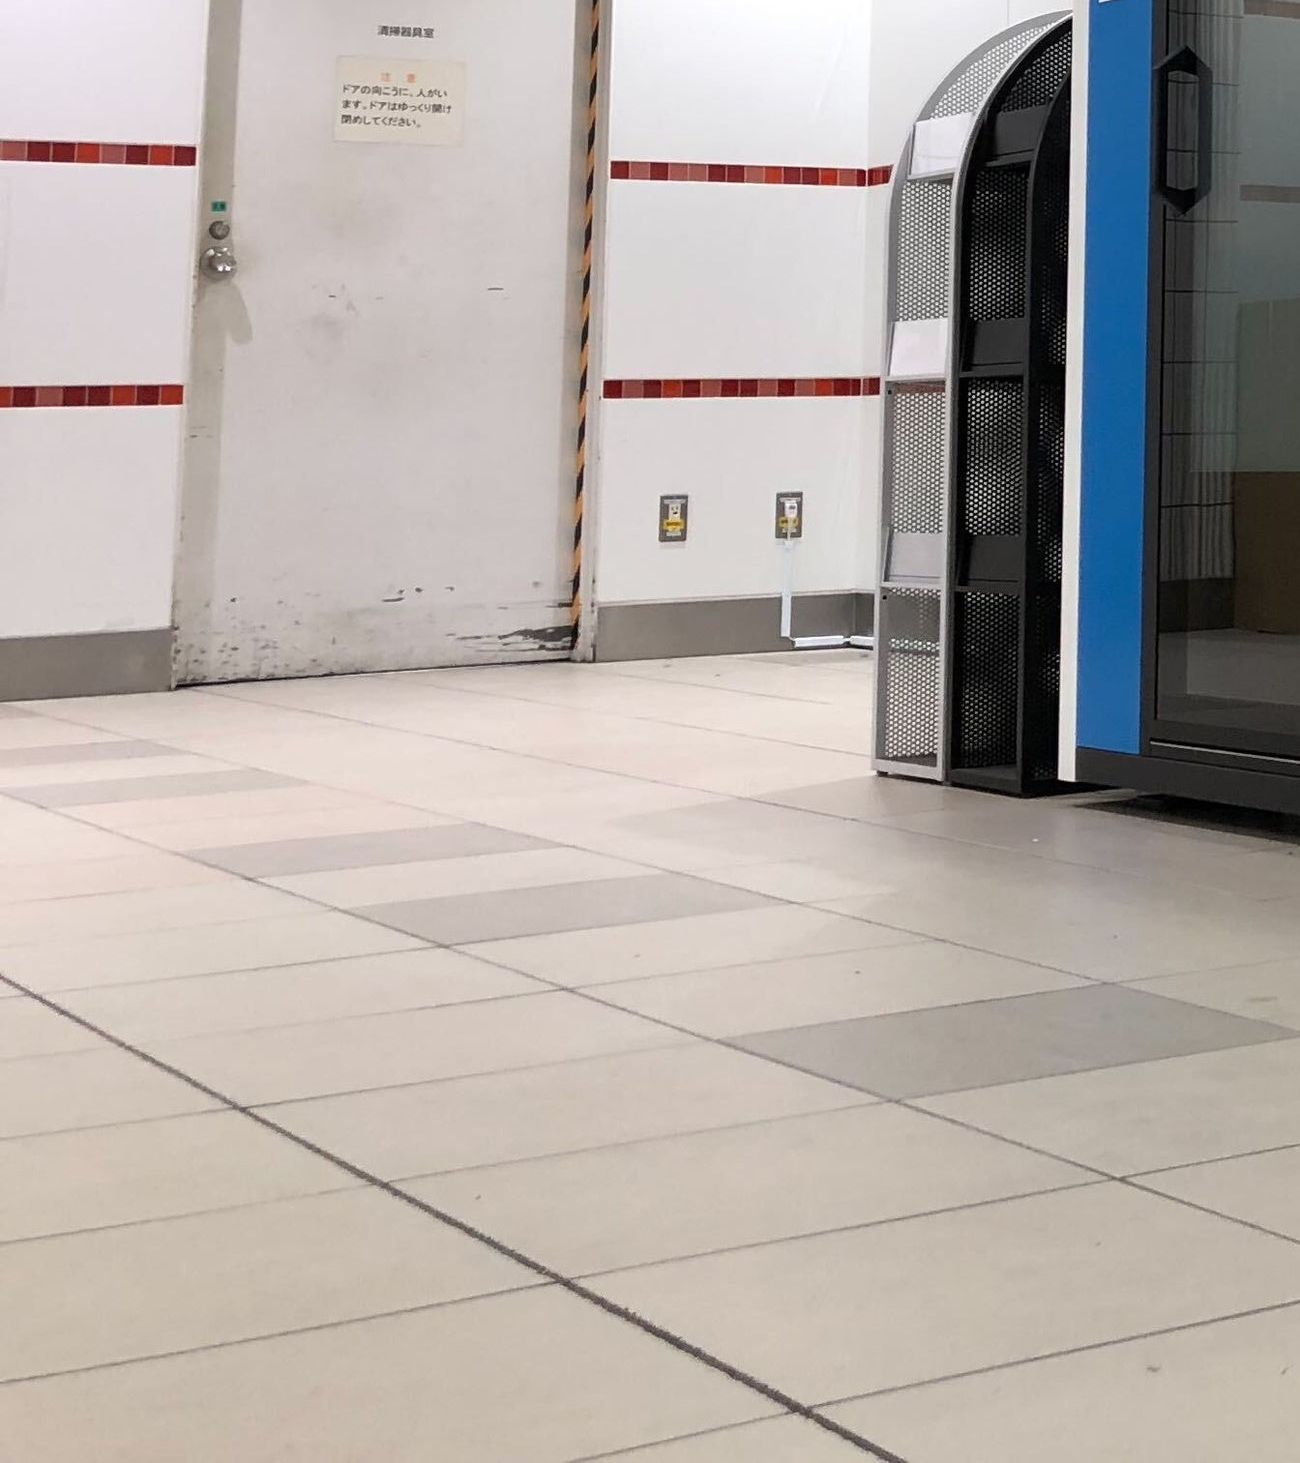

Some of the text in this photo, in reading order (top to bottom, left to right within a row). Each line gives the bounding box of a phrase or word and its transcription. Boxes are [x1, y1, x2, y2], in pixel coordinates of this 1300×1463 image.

[342, 83, 448, 99] ドアの向こうに、人がい
